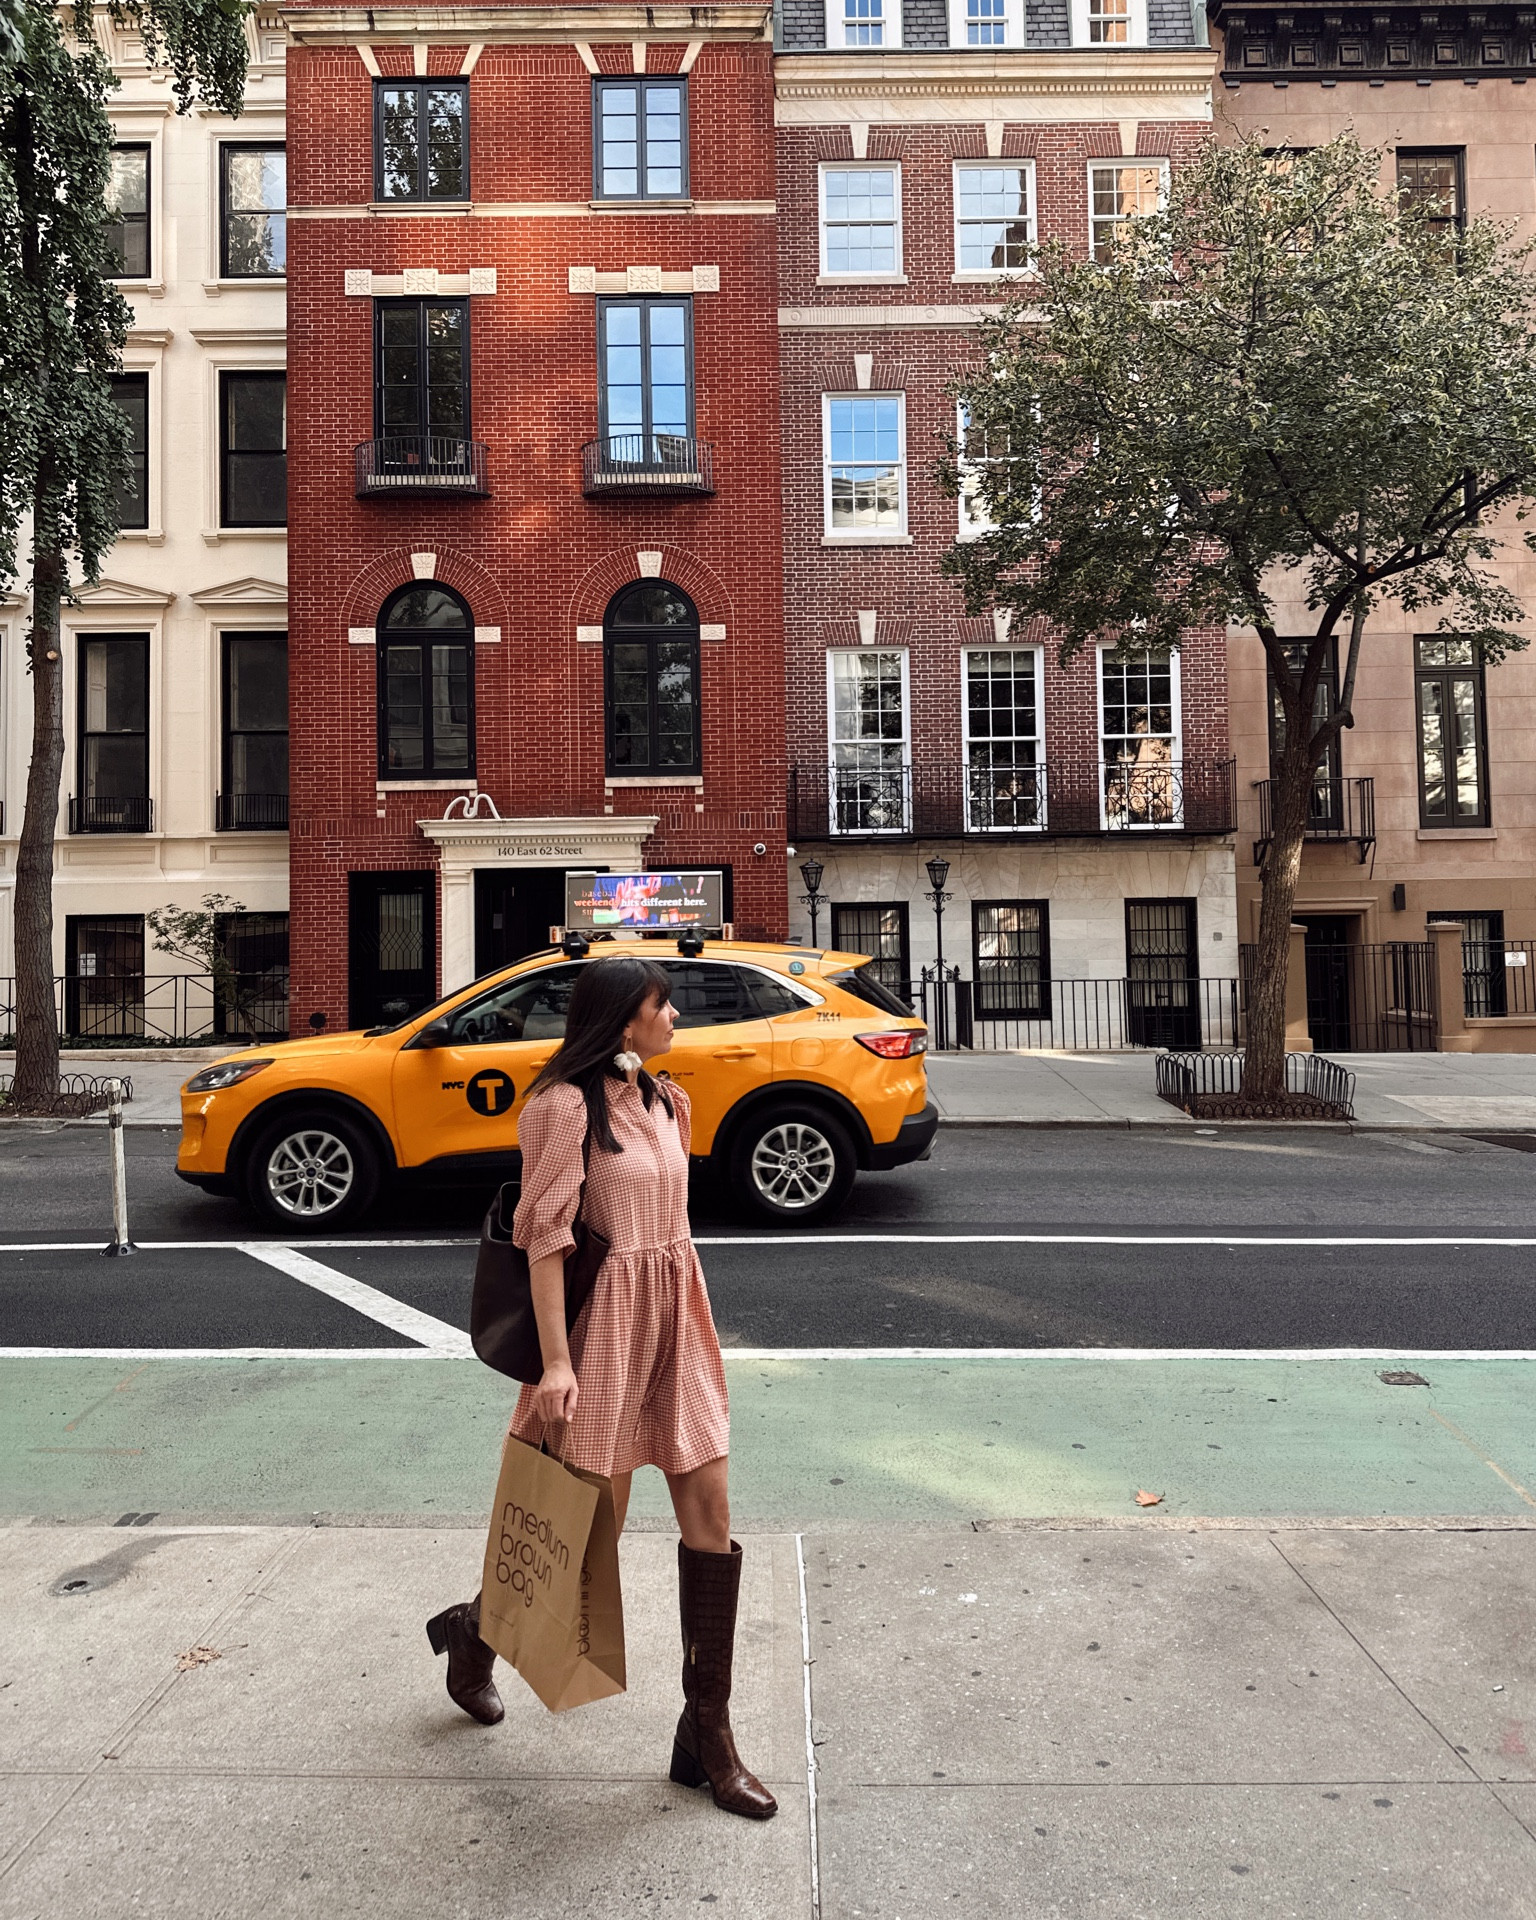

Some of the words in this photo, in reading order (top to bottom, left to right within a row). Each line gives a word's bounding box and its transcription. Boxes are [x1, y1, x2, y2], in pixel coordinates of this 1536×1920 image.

[498, 847, 515, 856] 140
[517, 847, 537, 856] East
[540, 846, 552, 856] 62
[554, 846, 583, 855] Street
[621, 898, 639, 907] hits
[641, 898, 682, 907] different
[684, 898, 707, 907] here.
[442, 1081, 465, 1090] NYC
[503, 1502, 570, 1570] medium
[500, 1525, 552, 1592] brown
[496, 1553, 534, 1608] bag
